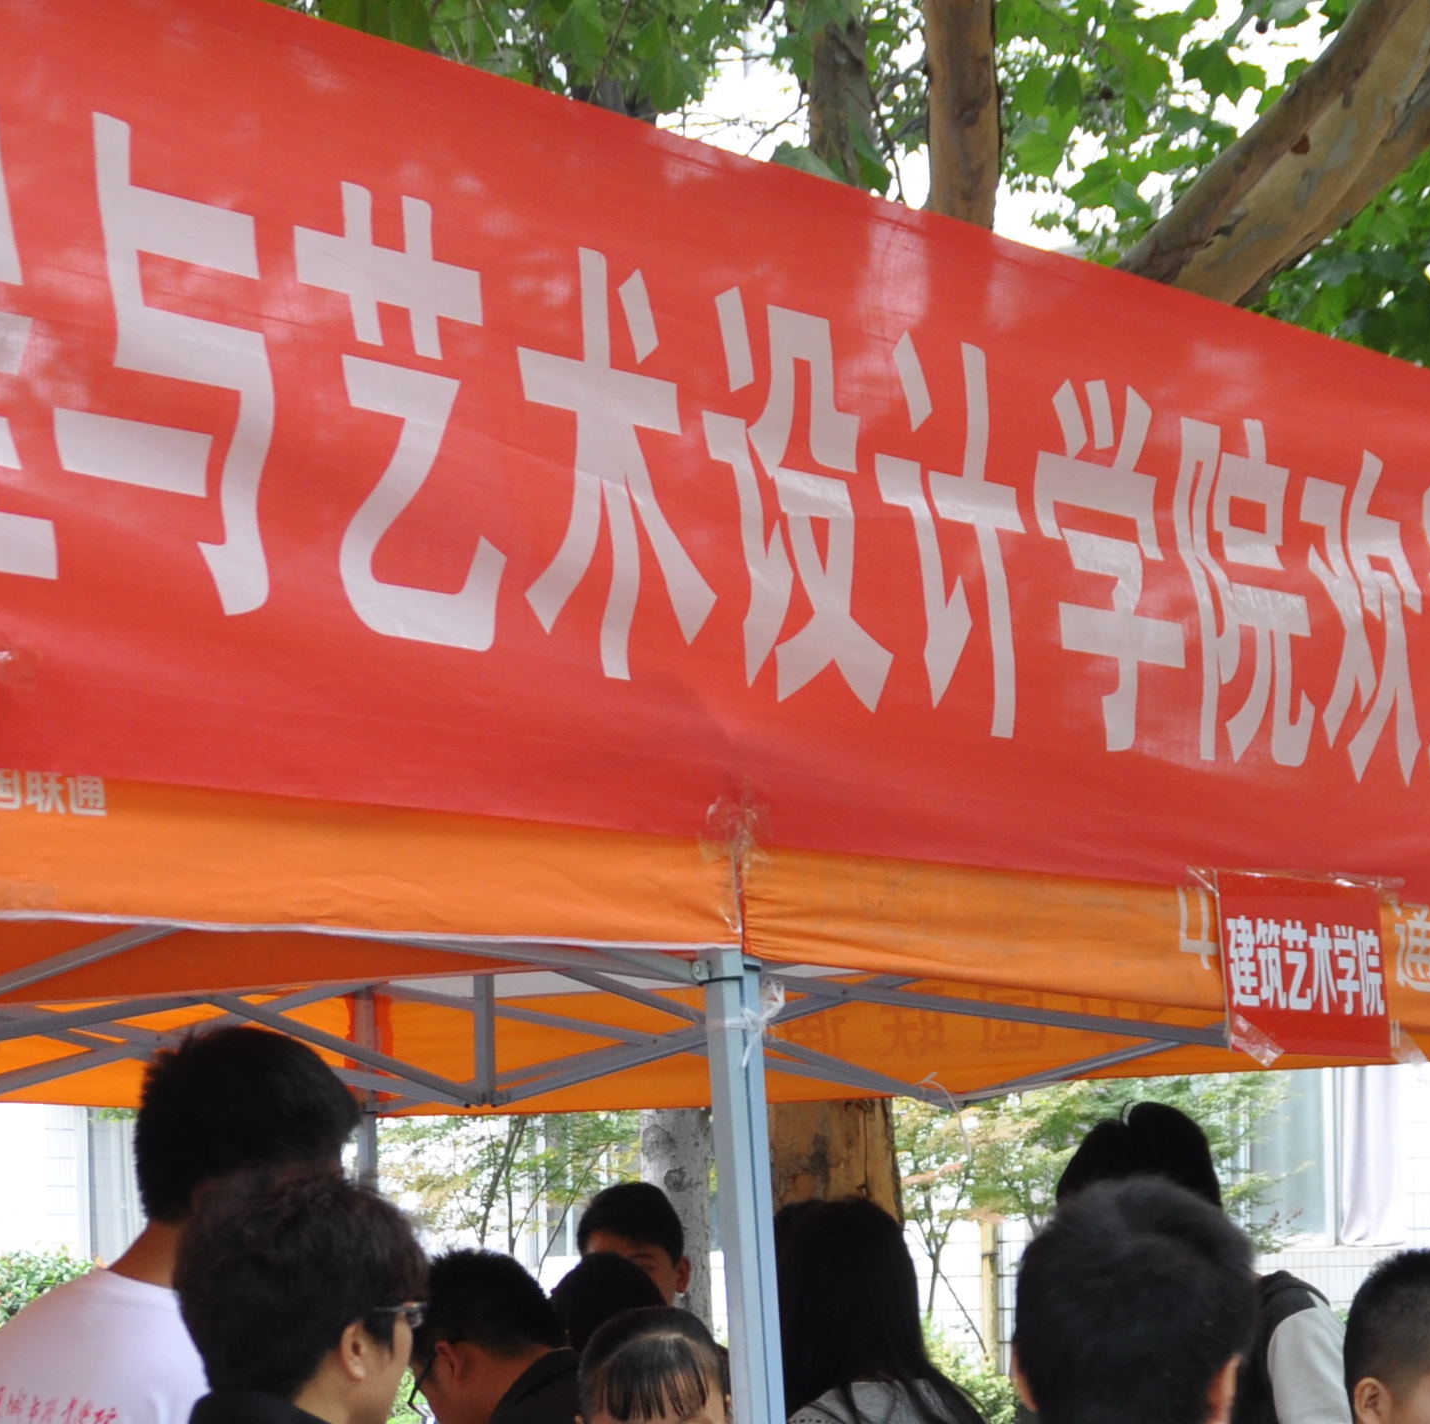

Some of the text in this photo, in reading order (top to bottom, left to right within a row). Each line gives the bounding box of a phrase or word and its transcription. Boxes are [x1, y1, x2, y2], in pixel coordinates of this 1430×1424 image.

[1226, 915, 1385, 1016] 建筑艺术学院
